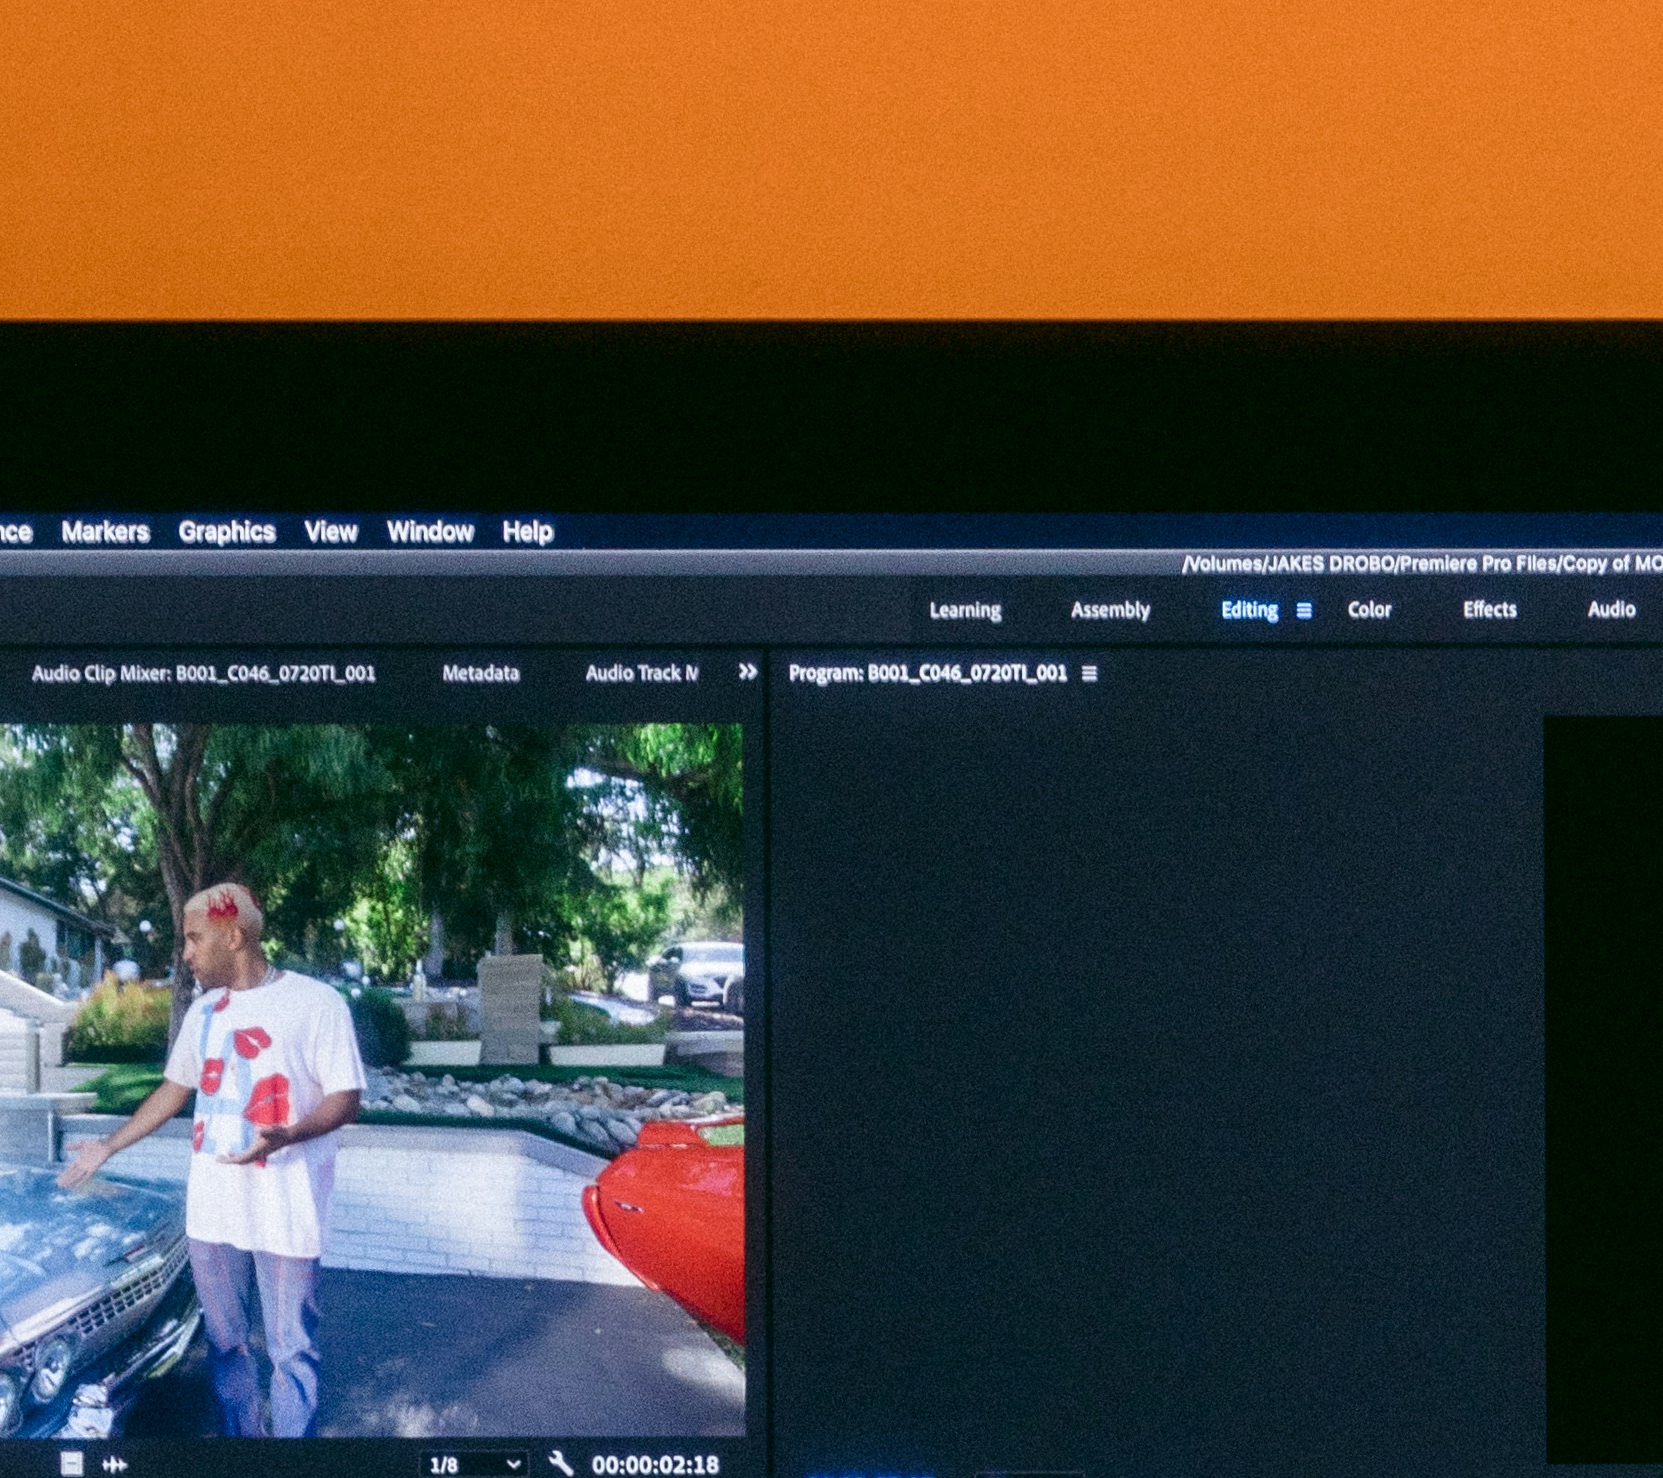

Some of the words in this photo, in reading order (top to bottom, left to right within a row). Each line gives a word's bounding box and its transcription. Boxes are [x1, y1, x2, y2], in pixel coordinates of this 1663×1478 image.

[62, 519, 151, 543] Markers
[178, 519, 277, 546] Graphics
[304, 519, 359, 543] View
[386, 519, 475, 543] Window
[502, 519, 555, 546] Help
[1181, 554, 1325, 574] /Volumes/JAKES
[1329, 554, 1478, 574] DROBO/Premiere
[1482, 554, 1512, 572] Pro
[1516, 554, 1608, 575] Files/Copy
[1612, 553, 1631, 572] of
[929, 601, 1002, 623] Learning
[1071, 600, 1151, 622] Assembly
[1221, 600, 1279, 623] Editing
[1347, 600, 1393, 619] Color
[1463, 599, 1518, 619] Effects
[1587, 599, 1637, 619] Audio
[31, 664, 81, 683] Audio
[84, 664, 117, 686] Clip
[120, 664, 171, 682] Mixer:
[442, 663, 521, 682] Metadata
[585, 663, 635, 682] Audio
[637, 663, 682, 682] Track
[789, 663, 864, 687] Program:
[430, 1456, 459, 1474] 1/8
[592, 1455, 720, 1475] 00:00:02:18
